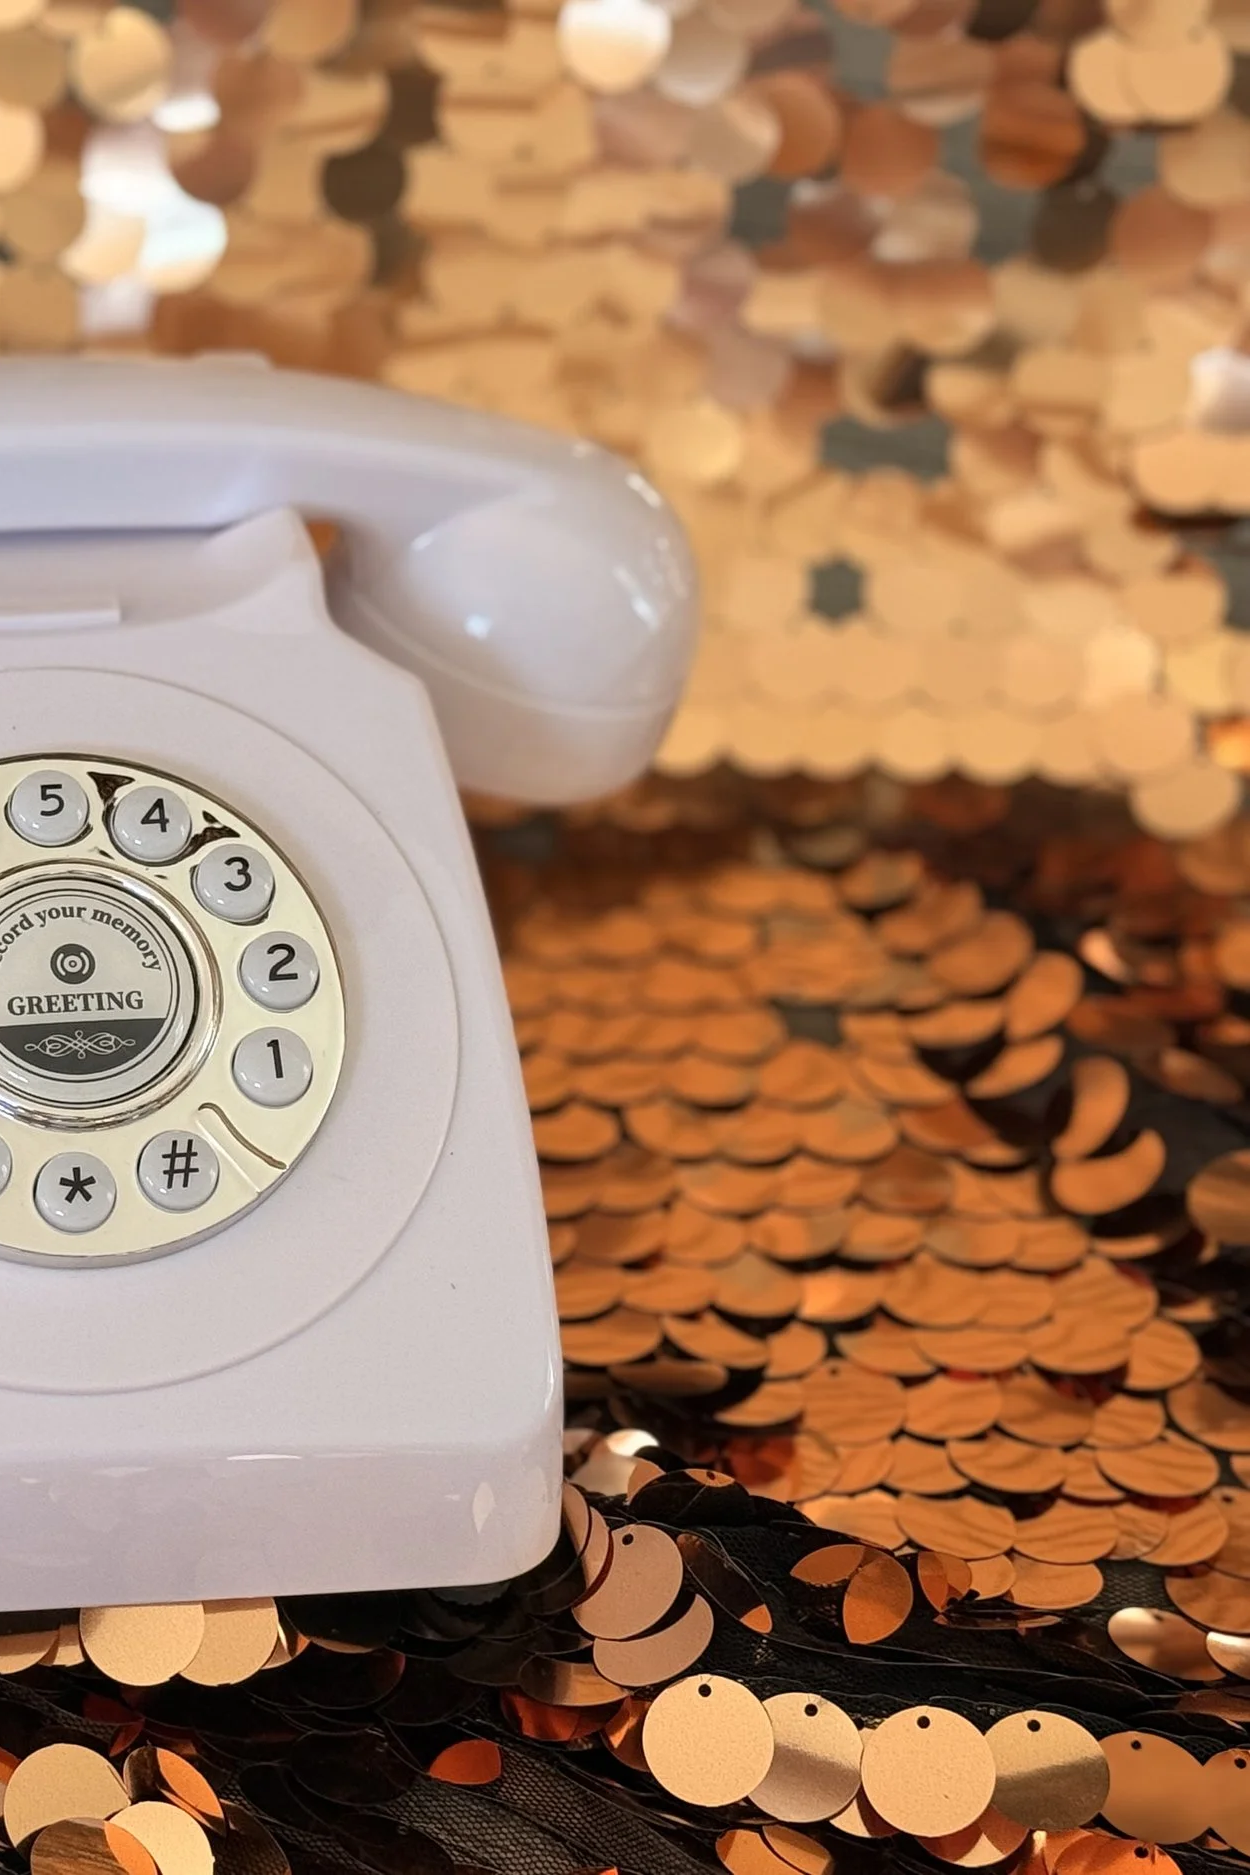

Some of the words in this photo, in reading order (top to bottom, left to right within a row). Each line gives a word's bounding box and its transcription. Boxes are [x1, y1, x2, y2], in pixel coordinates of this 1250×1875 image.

[40, 783, 65, 817] 5
[140, 797, 170, 833] 4
[224, 856, 252, 892] 3
[34, 905, 87, 927] your
[90, 908, 162, 972] memory
[266, 943, 299, 982] 2
[7, 990, 144, 1016] GREETING
[266, 1039, 284, 1079] 1
[161, 1138, 200, 1190] #
